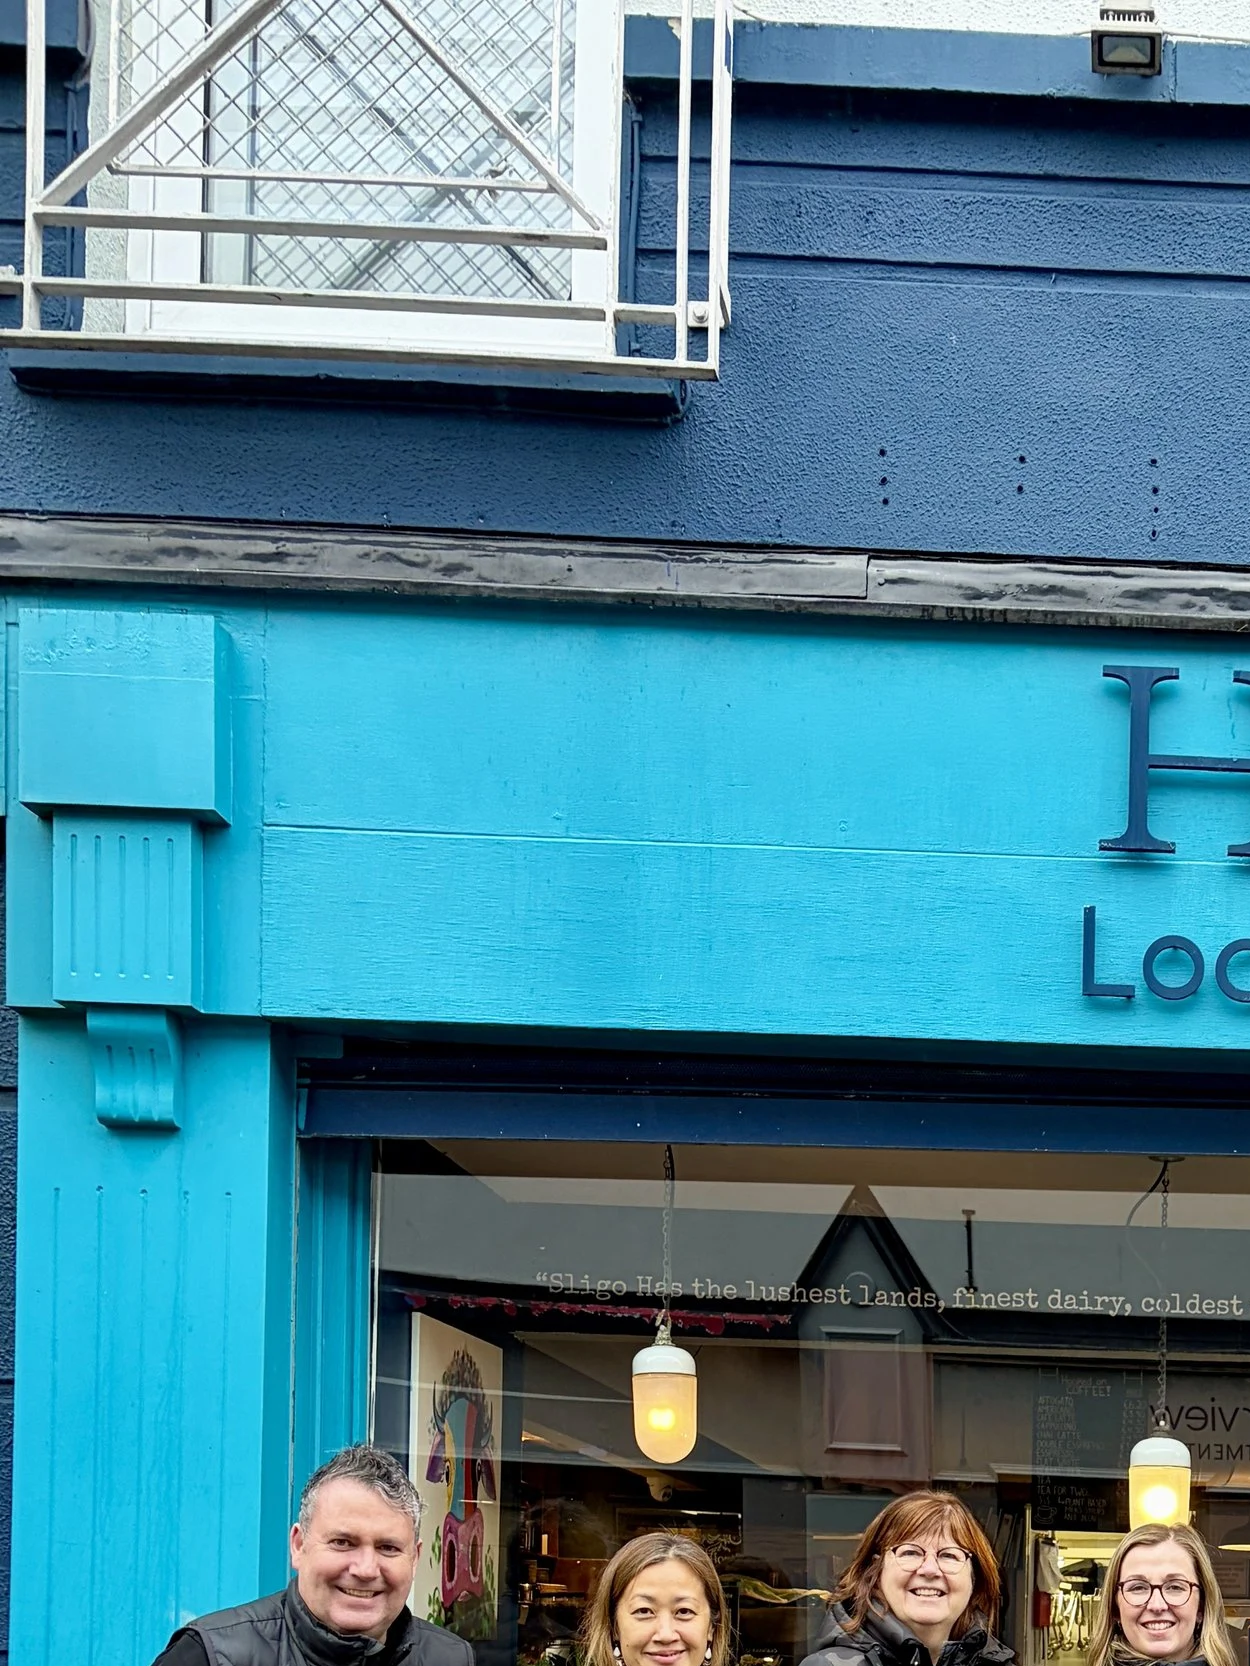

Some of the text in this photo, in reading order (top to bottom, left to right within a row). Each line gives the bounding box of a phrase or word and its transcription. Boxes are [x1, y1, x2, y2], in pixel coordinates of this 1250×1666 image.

[636, 1276, 683, 1297] Has
[692, 1278, 737, 1299] the
[746, 1280, 852, 1305] lushest
[859, 1285, 945, 1313] lands,
[952, 1286, 1039, 1309] finest
[1048, 1288, 1132, 1317] dairy,
[1141, 1292, 1243, 1316] coldest
